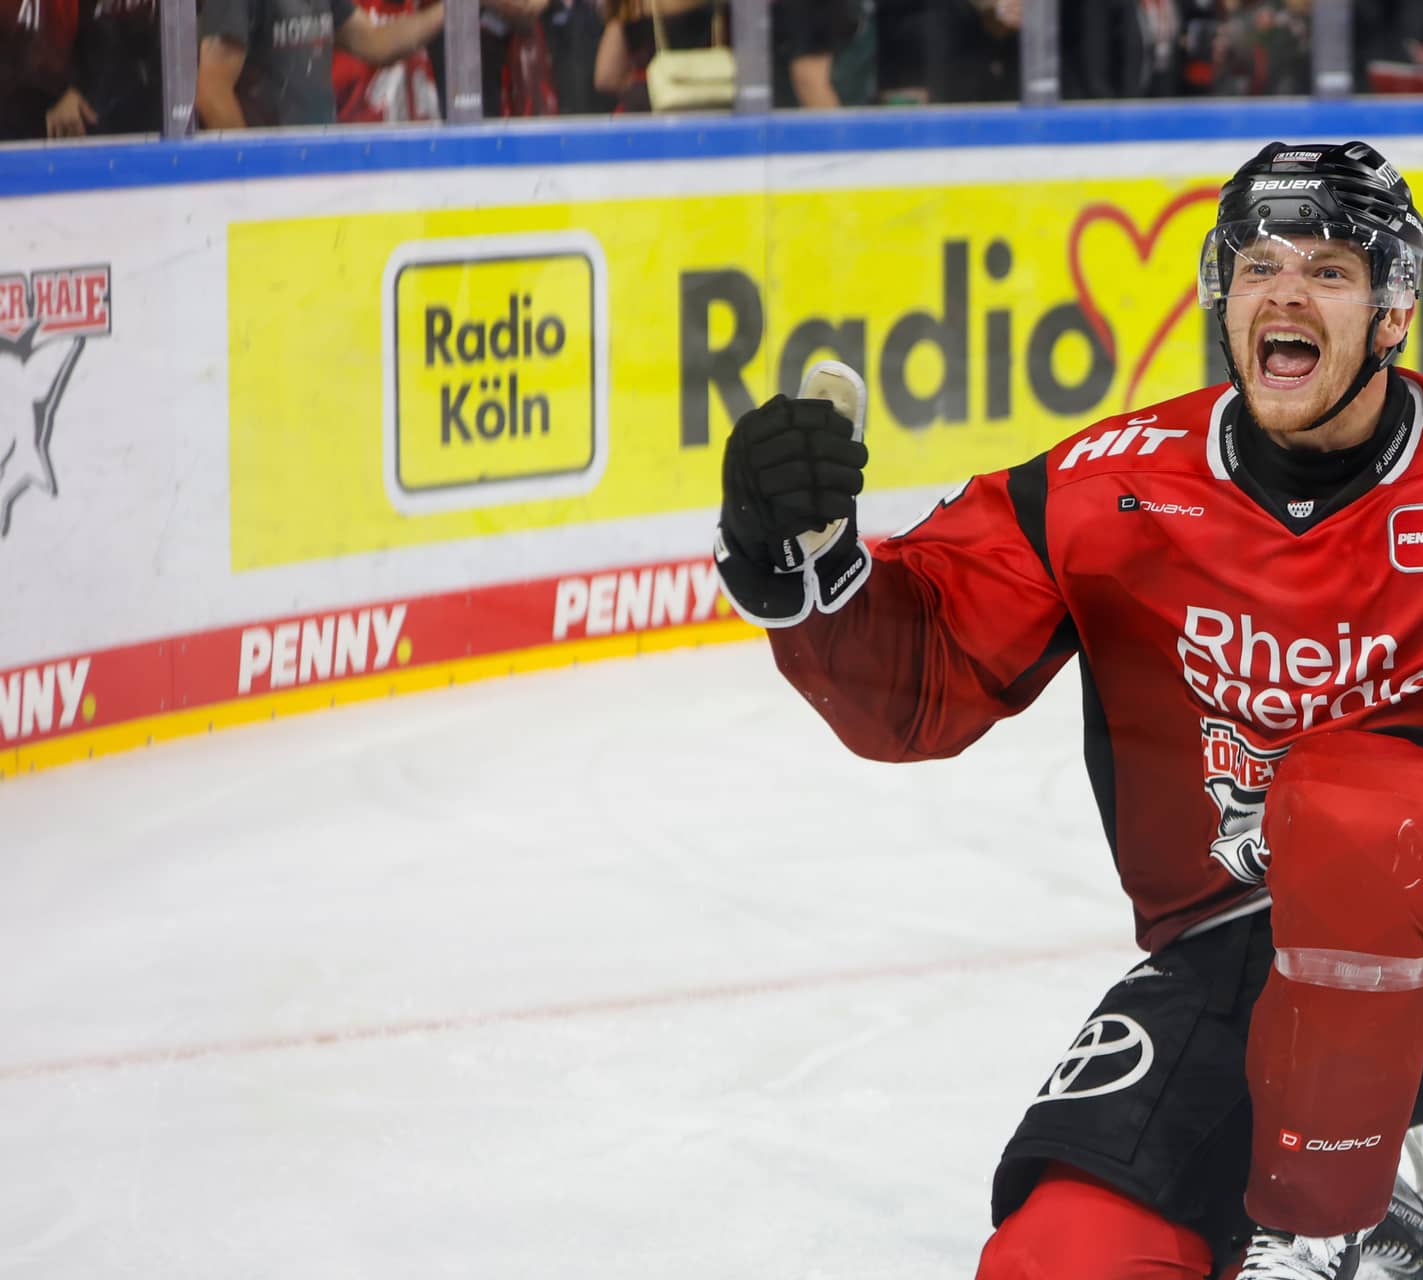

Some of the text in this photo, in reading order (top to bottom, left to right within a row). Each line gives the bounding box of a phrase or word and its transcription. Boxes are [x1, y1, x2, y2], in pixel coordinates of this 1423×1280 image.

[1251, 179, 1322, 191] BAUER
[36, 272, 107, 332] HAIE
[425, 294, 566, 368] Radio
[680, 238, 1118, 447] Radio
[440, 380, 551, 447] Köln
[1184, 605, 1398, 687] Rhein
